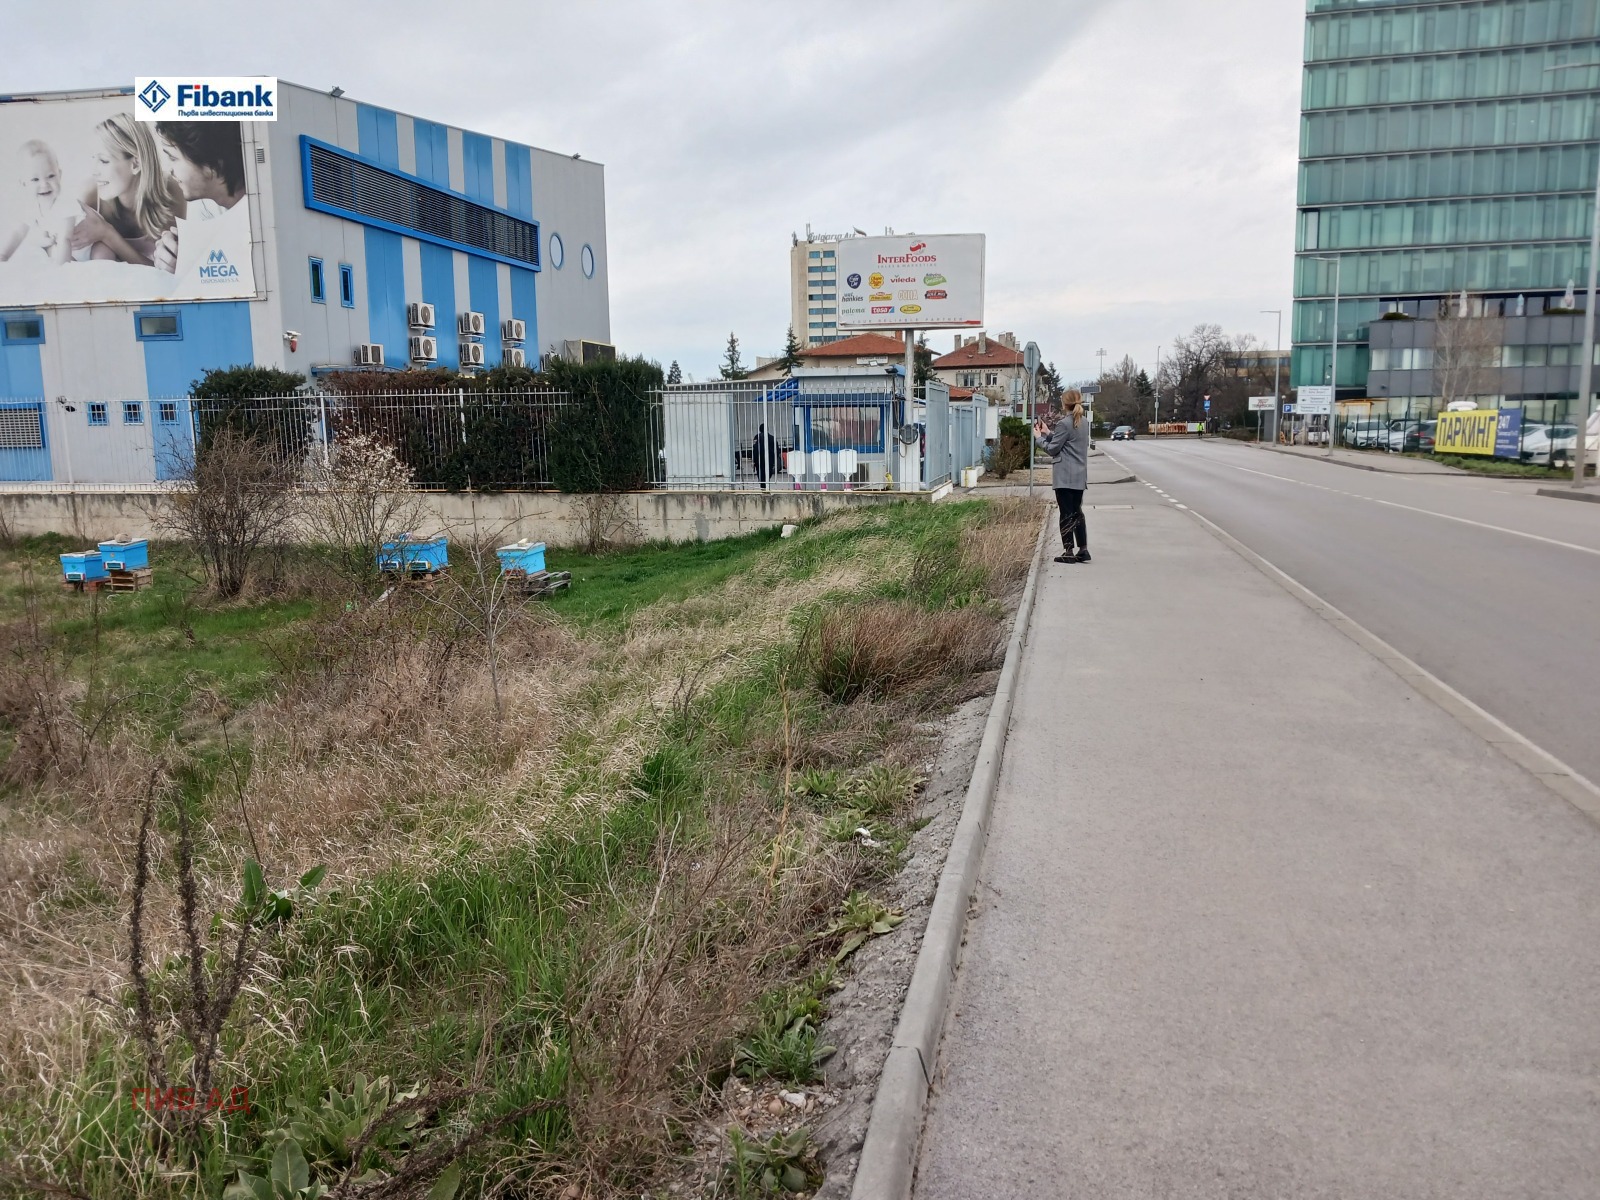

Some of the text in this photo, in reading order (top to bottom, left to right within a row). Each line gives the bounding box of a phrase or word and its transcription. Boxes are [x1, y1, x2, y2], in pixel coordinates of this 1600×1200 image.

[199, 265, 238, 278] MEGA
[890, 274, 916, 283] vileda
[1438, 416, 1496, 448] ПАРКИНГ
